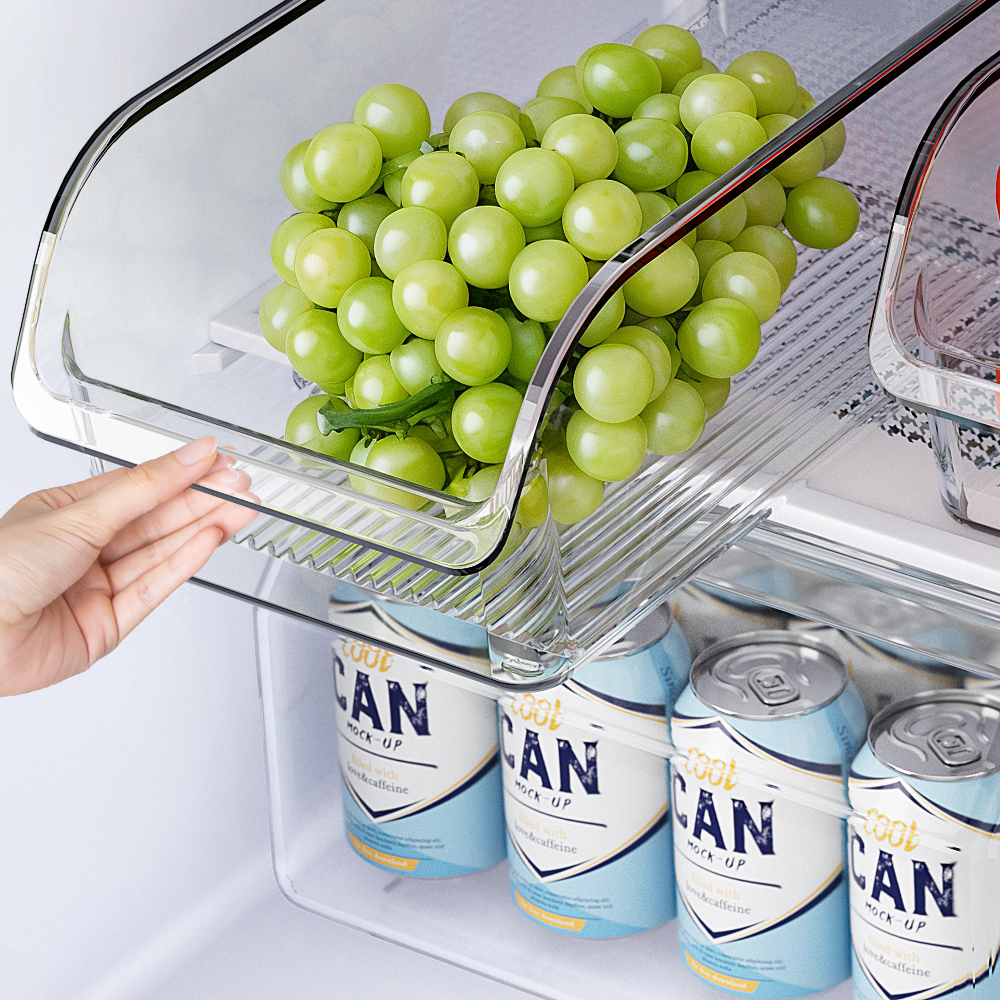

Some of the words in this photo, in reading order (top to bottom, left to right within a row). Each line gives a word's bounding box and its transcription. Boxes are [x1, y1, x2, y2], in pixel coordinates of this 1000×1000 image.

[333, 652, 432, 737] CAN
[346, 721, 403, 751] MOCK-UP
[351, 753, 372, 773] filled
[374, 766, 398, 781] with
[501, 711, 602, 796] CAN
[347, 761, 409, 795] love&caffeine
[515, 780, 572, 811] MOCK-UP
[518, 811, 541, 832] filled
[543, 825, 567, 840] with
[672, 770, 776, 856] CAN
[514, 820, 578, 854] love&caffeine
[687, 839, 747, 870] MOCK-UP
[691, 872, 713, 893] filled
[715, 886, 740, 901] with
[851, 832, 959, 918] CAN
[686, 880, 751, 915] love&caffeine
[865, 900, 927, 933] MOCK-UP
[863, 942, 931, 978] love&caffeine
[868, 935, 892, 955] filled
[894, 948, 920, 964] with
